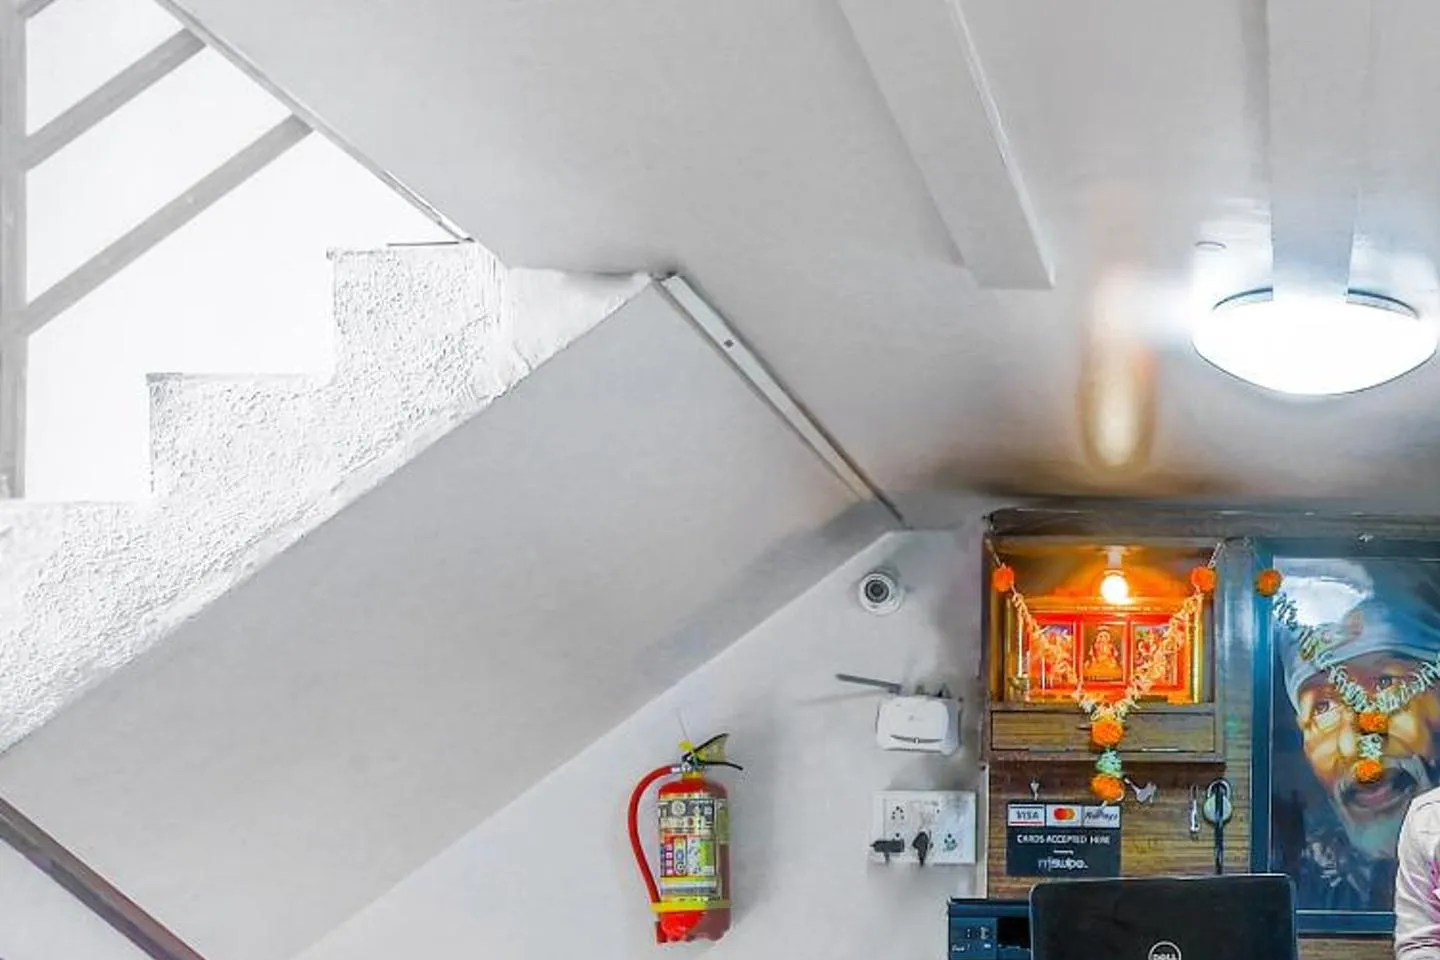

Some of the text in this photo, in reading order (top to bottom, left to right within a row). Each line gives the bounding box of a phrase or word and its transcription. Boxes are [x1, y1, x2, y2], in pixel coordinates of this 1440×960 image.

[1016, 810, 1039, 820] VISA
[1017, 834, 1110, 845] CARDS ACCEPTED HERE
